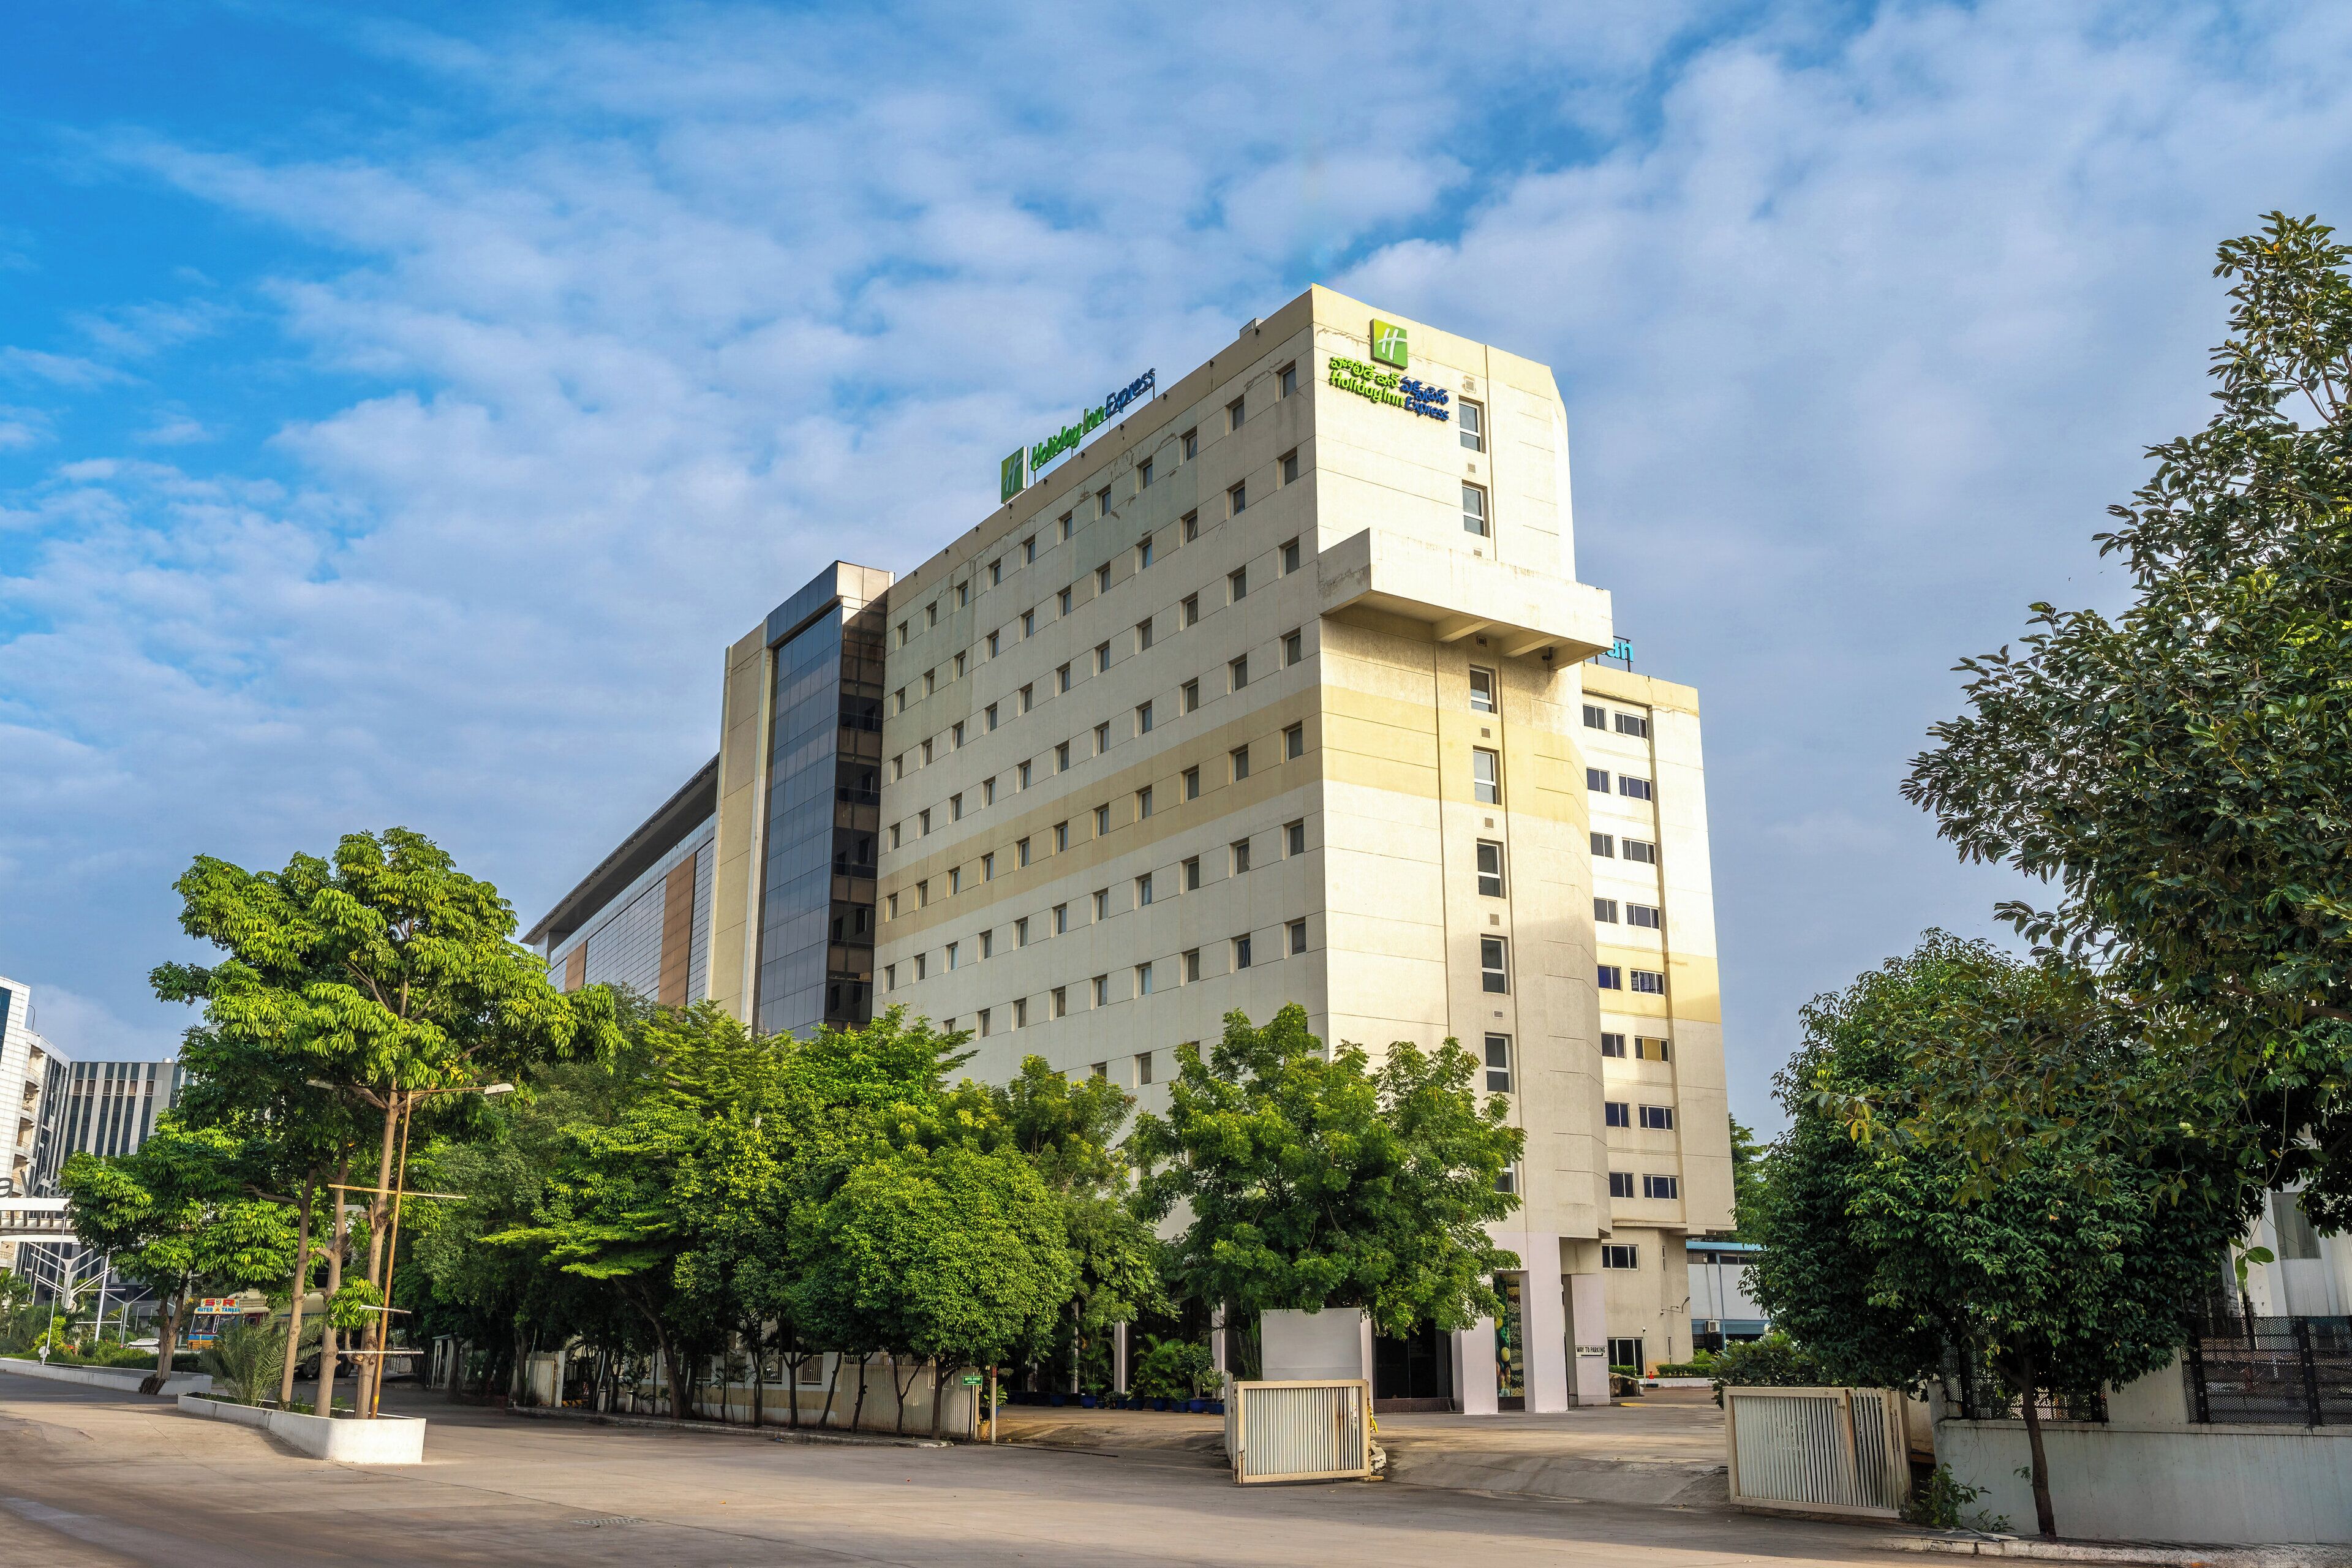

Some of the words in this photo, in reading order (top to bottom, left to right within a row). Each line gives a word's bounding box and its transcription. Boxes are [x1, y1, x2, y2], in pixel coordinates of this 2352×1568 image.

[1030, 422, 1083, 471] Holiday
[1082, 405, 1106, 434] Inn
[1105, 368, 1156, 418] Express
[1330, 369, 1384, 403] Holiday
[1384, 386, 1404, 407] Inn
[1404, 396, 1449, 421] Express
